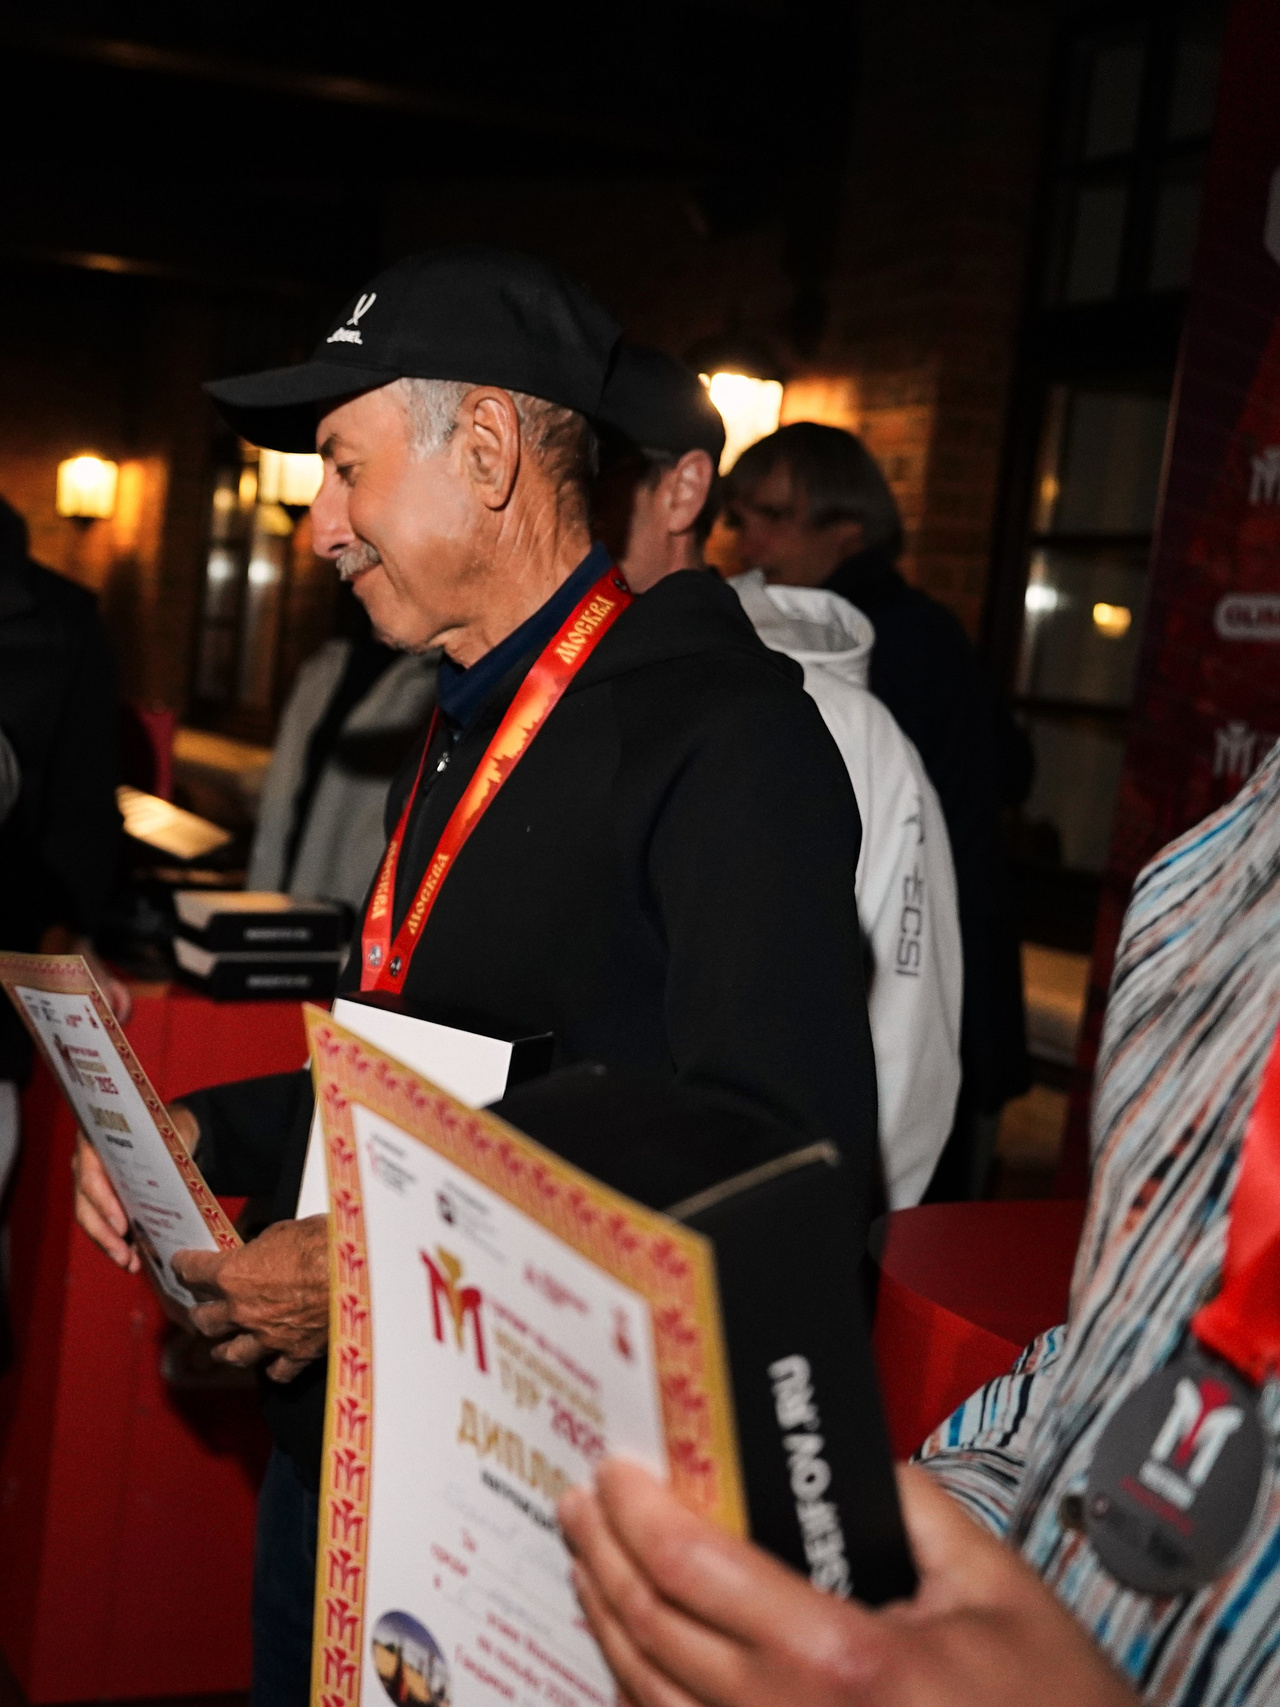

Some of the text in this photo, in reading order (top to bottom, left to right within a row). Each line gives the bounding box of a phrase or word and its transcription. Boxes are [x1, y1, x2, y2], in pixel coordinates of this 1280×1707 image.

[555, 594, 615, 665] МОСКВА
[407, 853, 450, 935] МОСКВА
[456, 1398, 569, 1500] ДИПЛО
